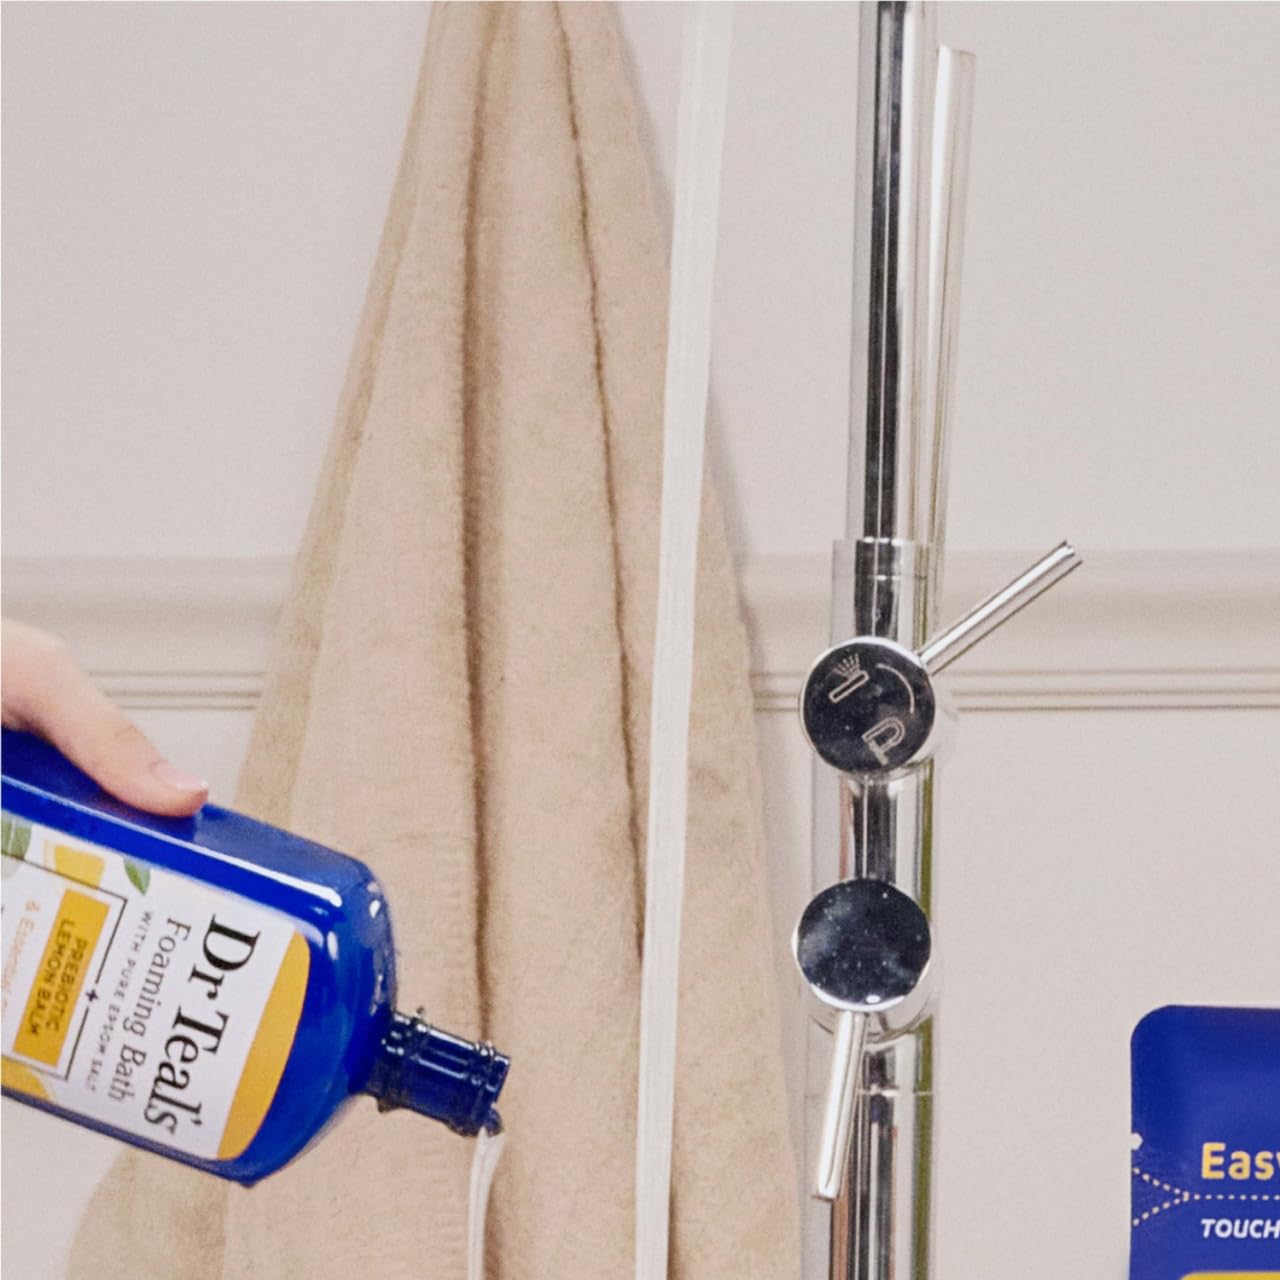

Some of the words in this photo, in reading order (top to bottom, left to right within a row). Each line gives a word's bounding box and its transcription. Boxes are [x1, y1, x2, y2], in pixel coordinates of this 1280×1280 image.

[44, 919, 75, 985] LEMON
[133, 911, 152, 952] WITH
[188, 913, 261, 1000] Dr
[46, 936, 87, 1032] PREBIOTIC
[114, 958, 136, 1000] PURE
[123, 918, 192, 1037] Foaming
[108, 1044, 147, 1101] Bath
[144, 1005, 230, 1135] Teal's
[1201, 1219, 1280, 1238] TOUCH
